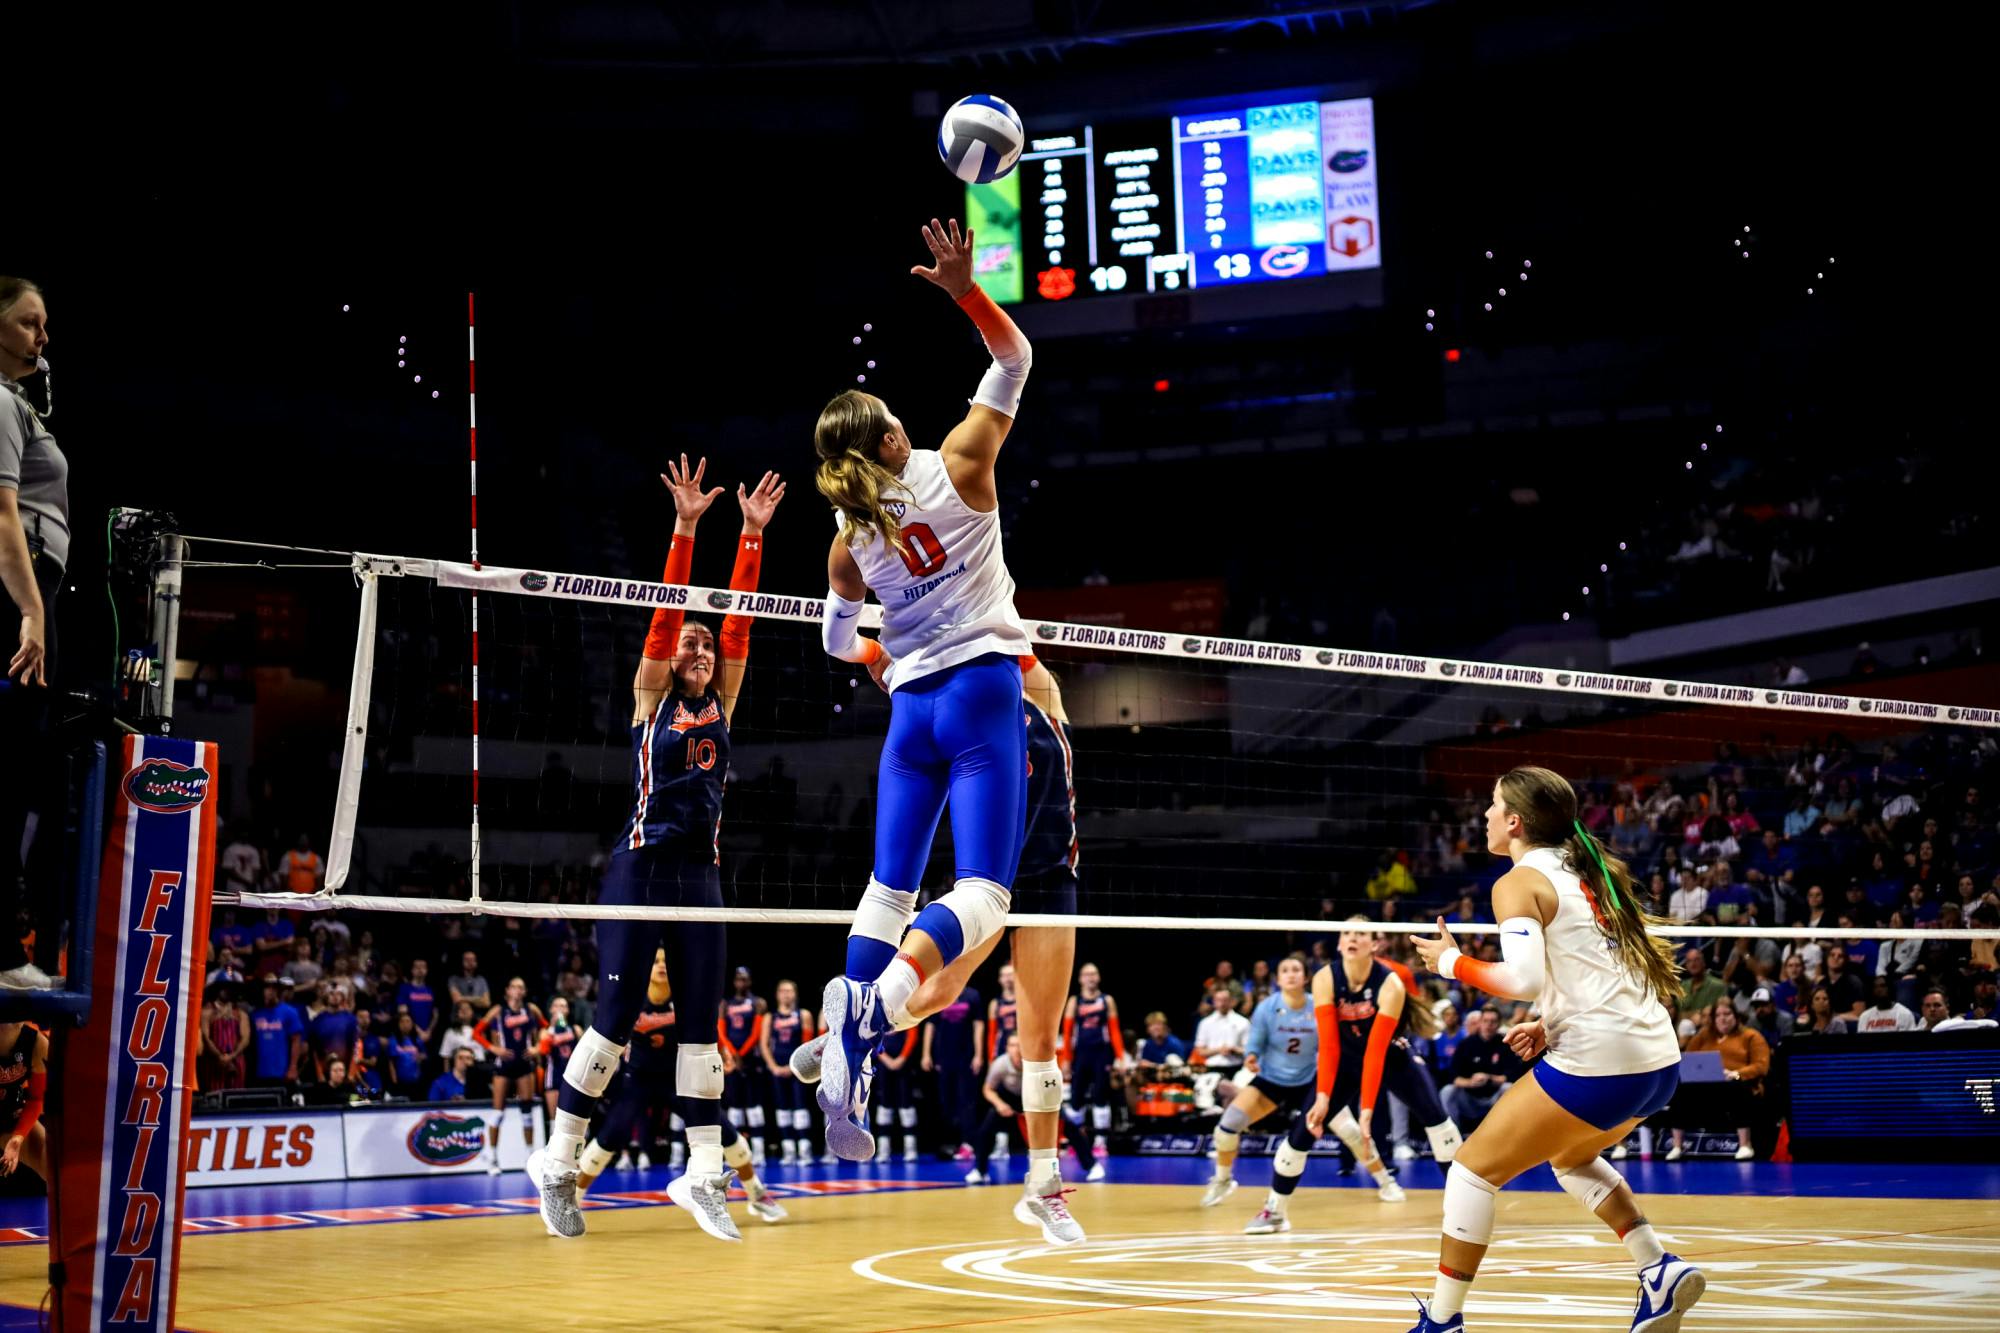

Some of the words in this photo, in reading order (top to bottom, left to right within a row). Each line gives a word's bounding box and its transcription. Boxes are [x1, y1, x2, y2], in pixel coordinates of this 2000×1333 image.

[1214, 253, 1251, 279] 13
[553, 576, 622, 598] FLORIDA
[625, 583, 689, 605] GATORS
[737, 594, 800, 616] FLORIDA
[1062, 626, 1115, 646] FLORIDA
[1118, 632, 1166, 650] GATORS
[1205, 640, 1254, 658] FLORIDA
[1257, 645, 1302, 662] GATORS
[1337, 652, 1382, 669] FLORIDA
[1385, 656, 1427, 673] GATORS
[1460, 664, 1503, 680] FLORIDA
[1505, 668, 1543, 684] GATORS
[1574, 675, 1614, 691] FLORIDA
[1616, 679, 1652, 694] GATORS
[1681, 684, 1718, 699] FLORIDA
[1720, 688, 1754, 702] GATORS
[1781, 693, 1815, 707] FLORIDA
[1817, 696, 1849, 710] GATORS
[1875, 701, 1907, 715] FLORIDA
[1908, 704, 1938, 718] GATORS
[1961, 709, 1992, 722] FLORIDA
[685, 738, 717, 770] 10
[1287, 1037, 1301, 1054] 2
[107, 869, 183, 1323] FLORIDA
[186, 1124, 315, 1172] TILES
